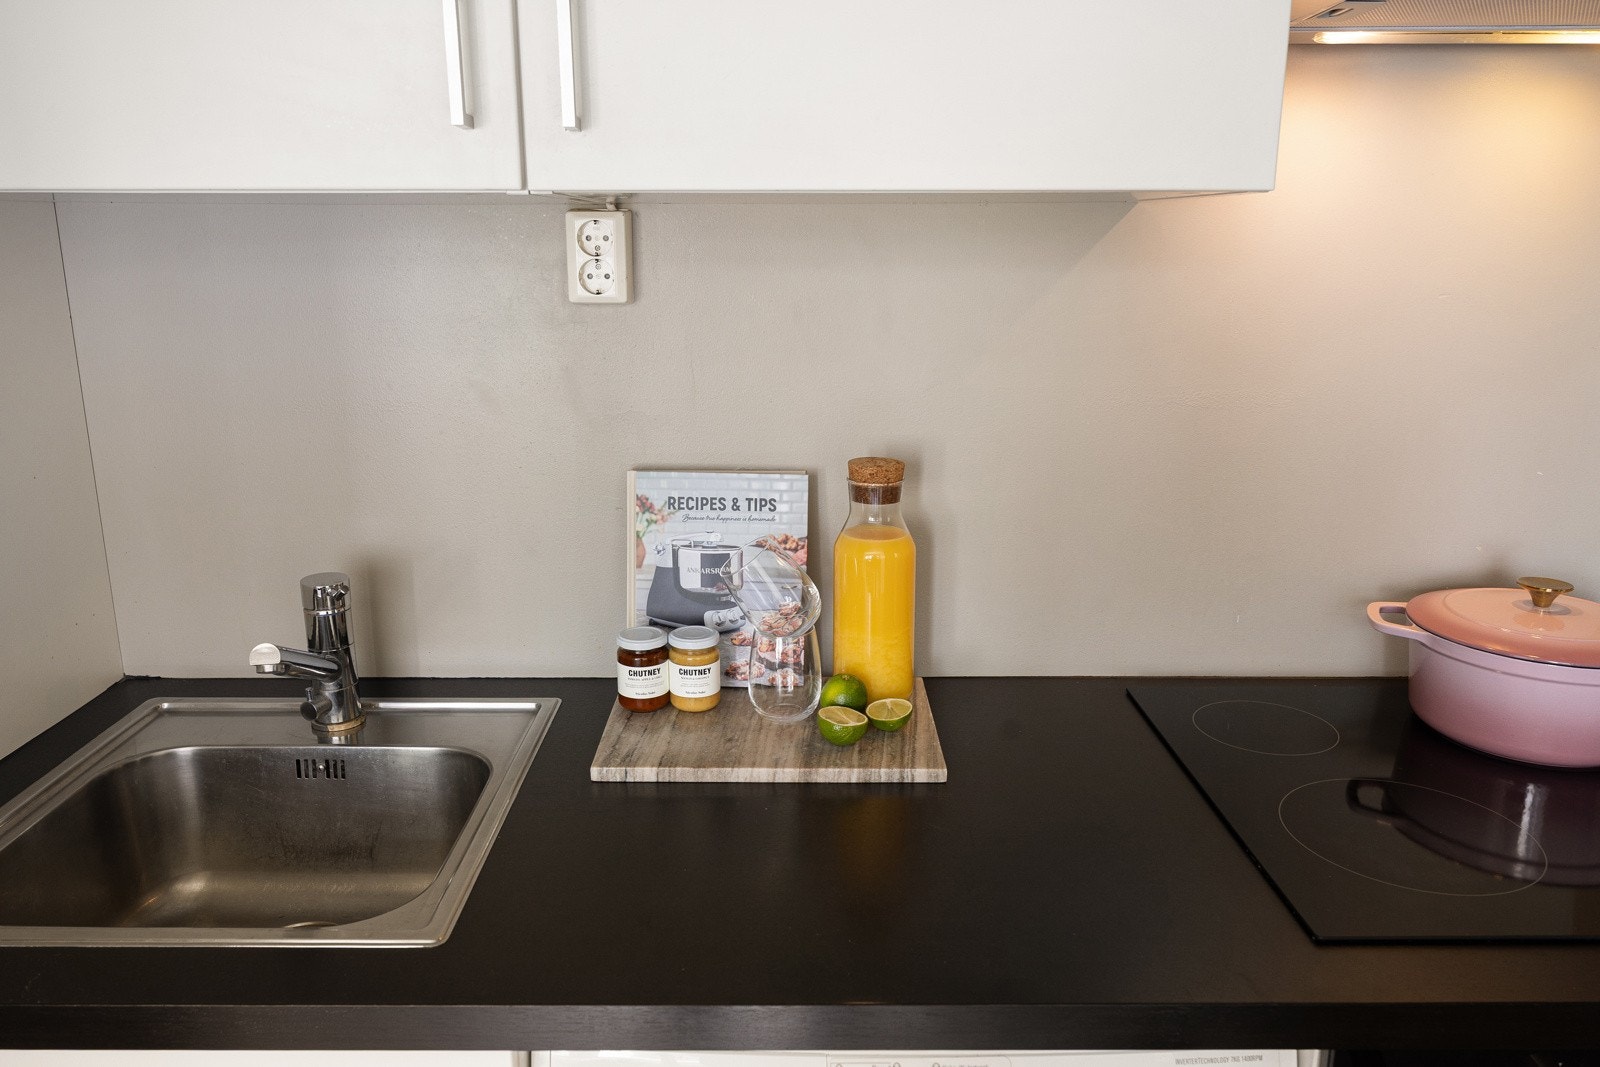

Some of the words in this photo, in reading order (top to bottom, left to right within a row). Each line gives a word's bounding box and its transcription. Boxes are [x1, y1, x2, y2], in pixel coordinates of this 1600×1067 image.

[667, 496, 726, 511] RECIPES
[731, 497, 741, 512] &
[745, 497, 777, 512] TIPS
[681, 513, 705, 522] Because
[628, 668, 661, 677] CHUTNEY
[678, 667, 712, 676] CHUTNEY
